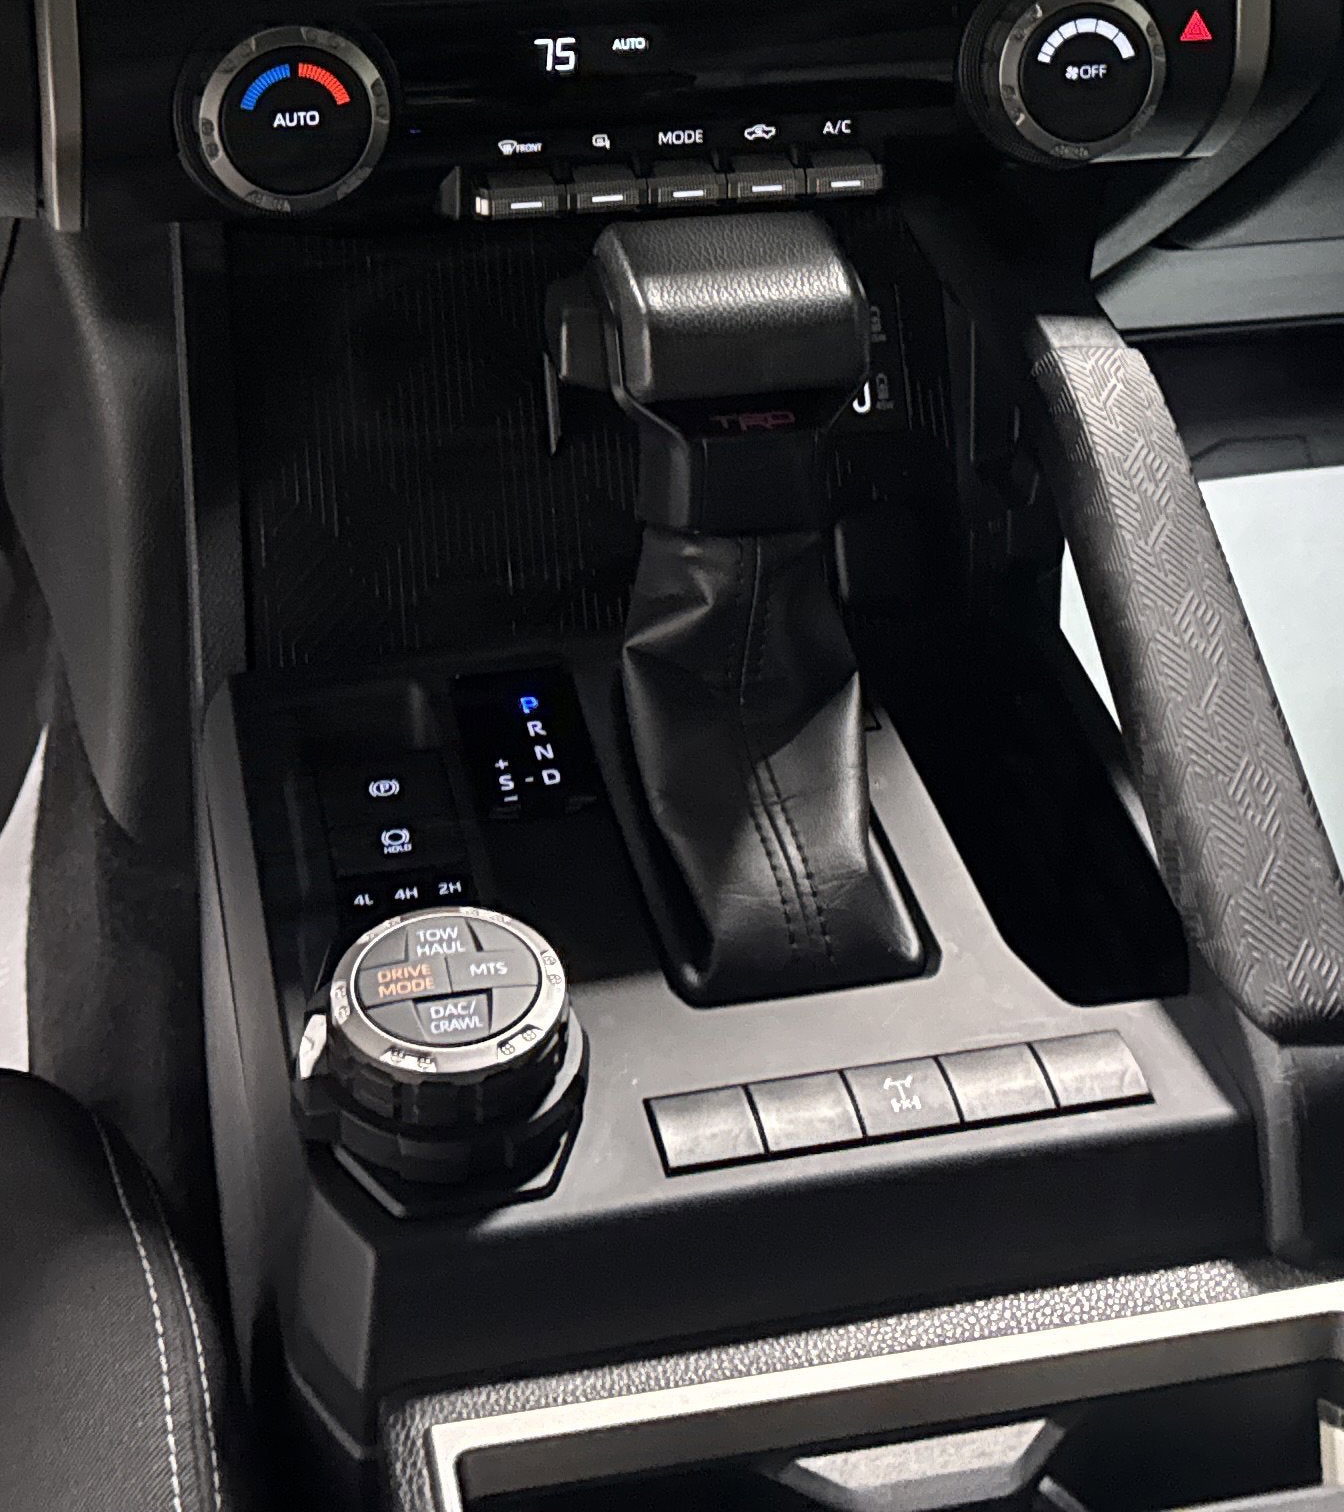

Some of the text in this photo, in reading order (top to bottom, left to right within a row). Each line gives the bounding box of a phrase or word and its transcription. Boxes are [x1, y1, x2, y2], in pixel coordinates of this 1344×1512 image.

[612, 37, 646, 51] AUTO
[534, 37, 577, 72] 75
[1079, 63, 1108, 80] OFF
[272, 110, 320, 128] AUTO
[823, 119, 852, 136] A/C
[658, 129, 704, 146] MODE
[710, 410, 795, 432] TRD
[520, 696, 539, 714] P
[527, 720, 547, 737] R
[534, 743, 554, 761] N
[499, 768, 561, 791] S D
[383, 842, 412, 855] HOLD
[353, 881, 462, 907] 4L 4H 2H
[415, 926, 459, 943] TOW
[416, 941, 466, 958] HAUL
[377, 962, 432, 983] DRIVE
[469, 961, 508, 977] MTS
[378, 977, 435, 999] MODE
[429, 999, 477, 1019] DAC/
[430, 1015, 484, 1035] CRAWL
